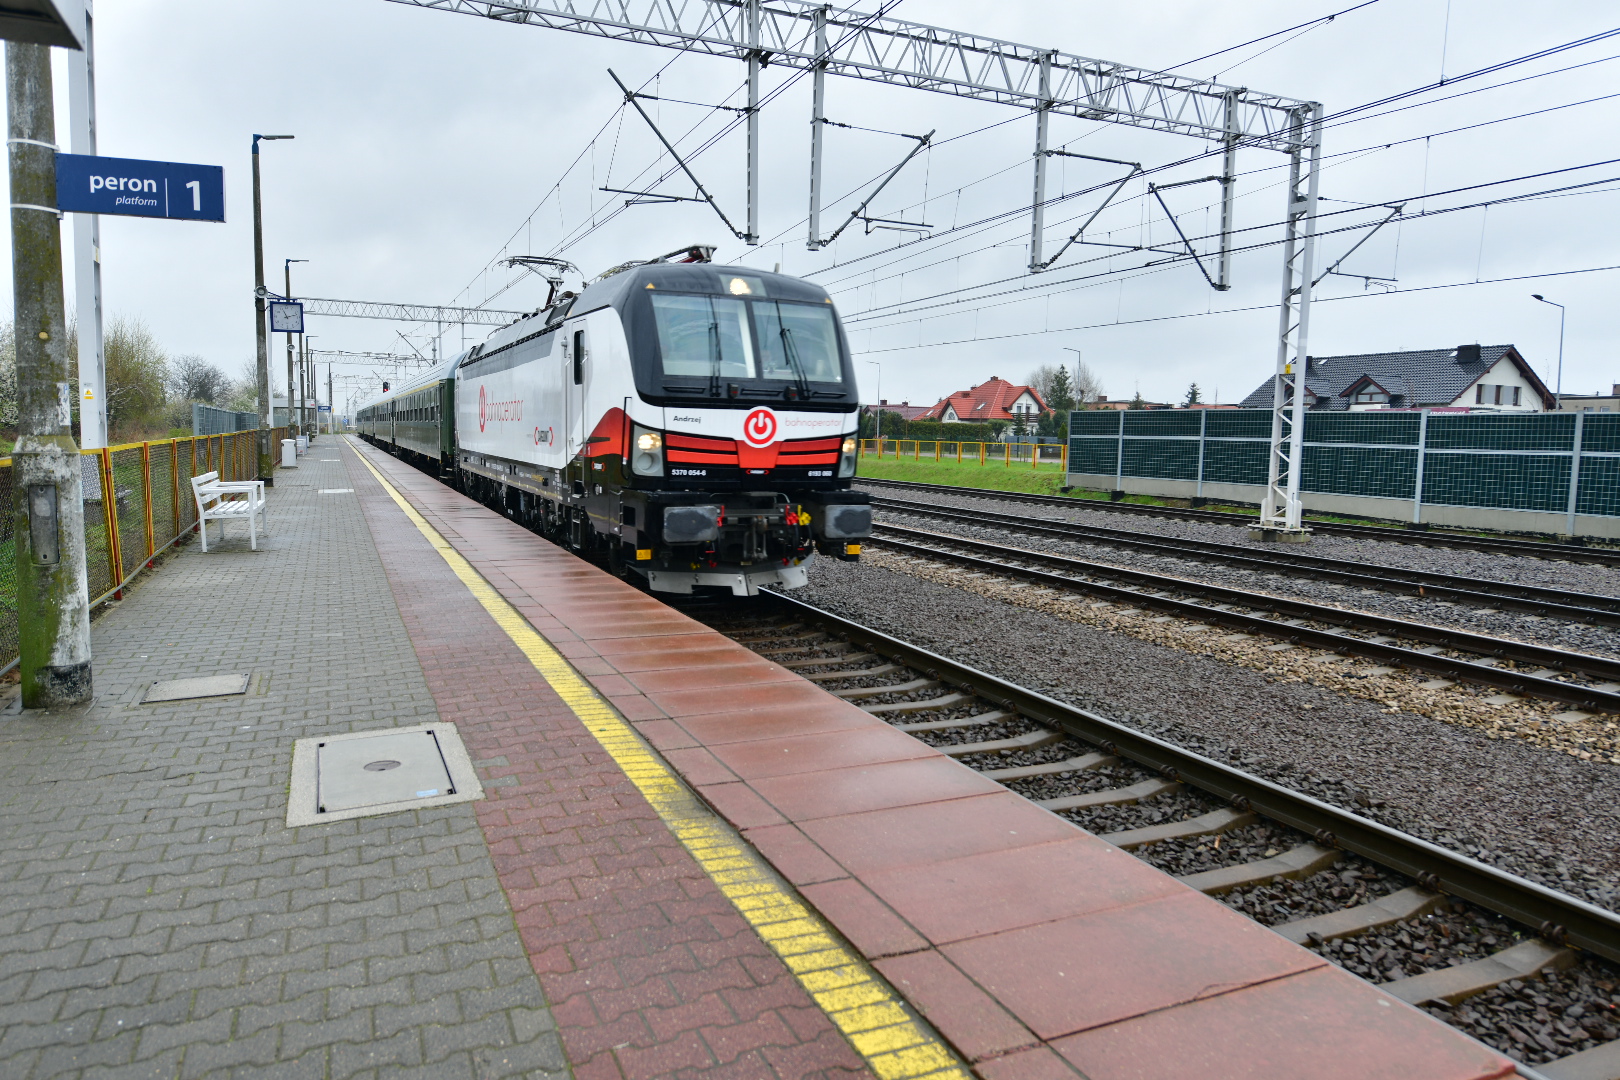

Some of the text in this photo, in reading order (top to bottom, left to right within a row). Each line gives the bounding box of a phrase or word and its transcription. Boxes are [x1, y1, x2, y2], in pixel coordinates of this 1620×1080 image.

[89, 175, 201, 212] peron 1
[115, 195, 158, 207] platform
[673, 415, 701, 424] Andrzej
[785, 417, 842, 429] bahnoperator
